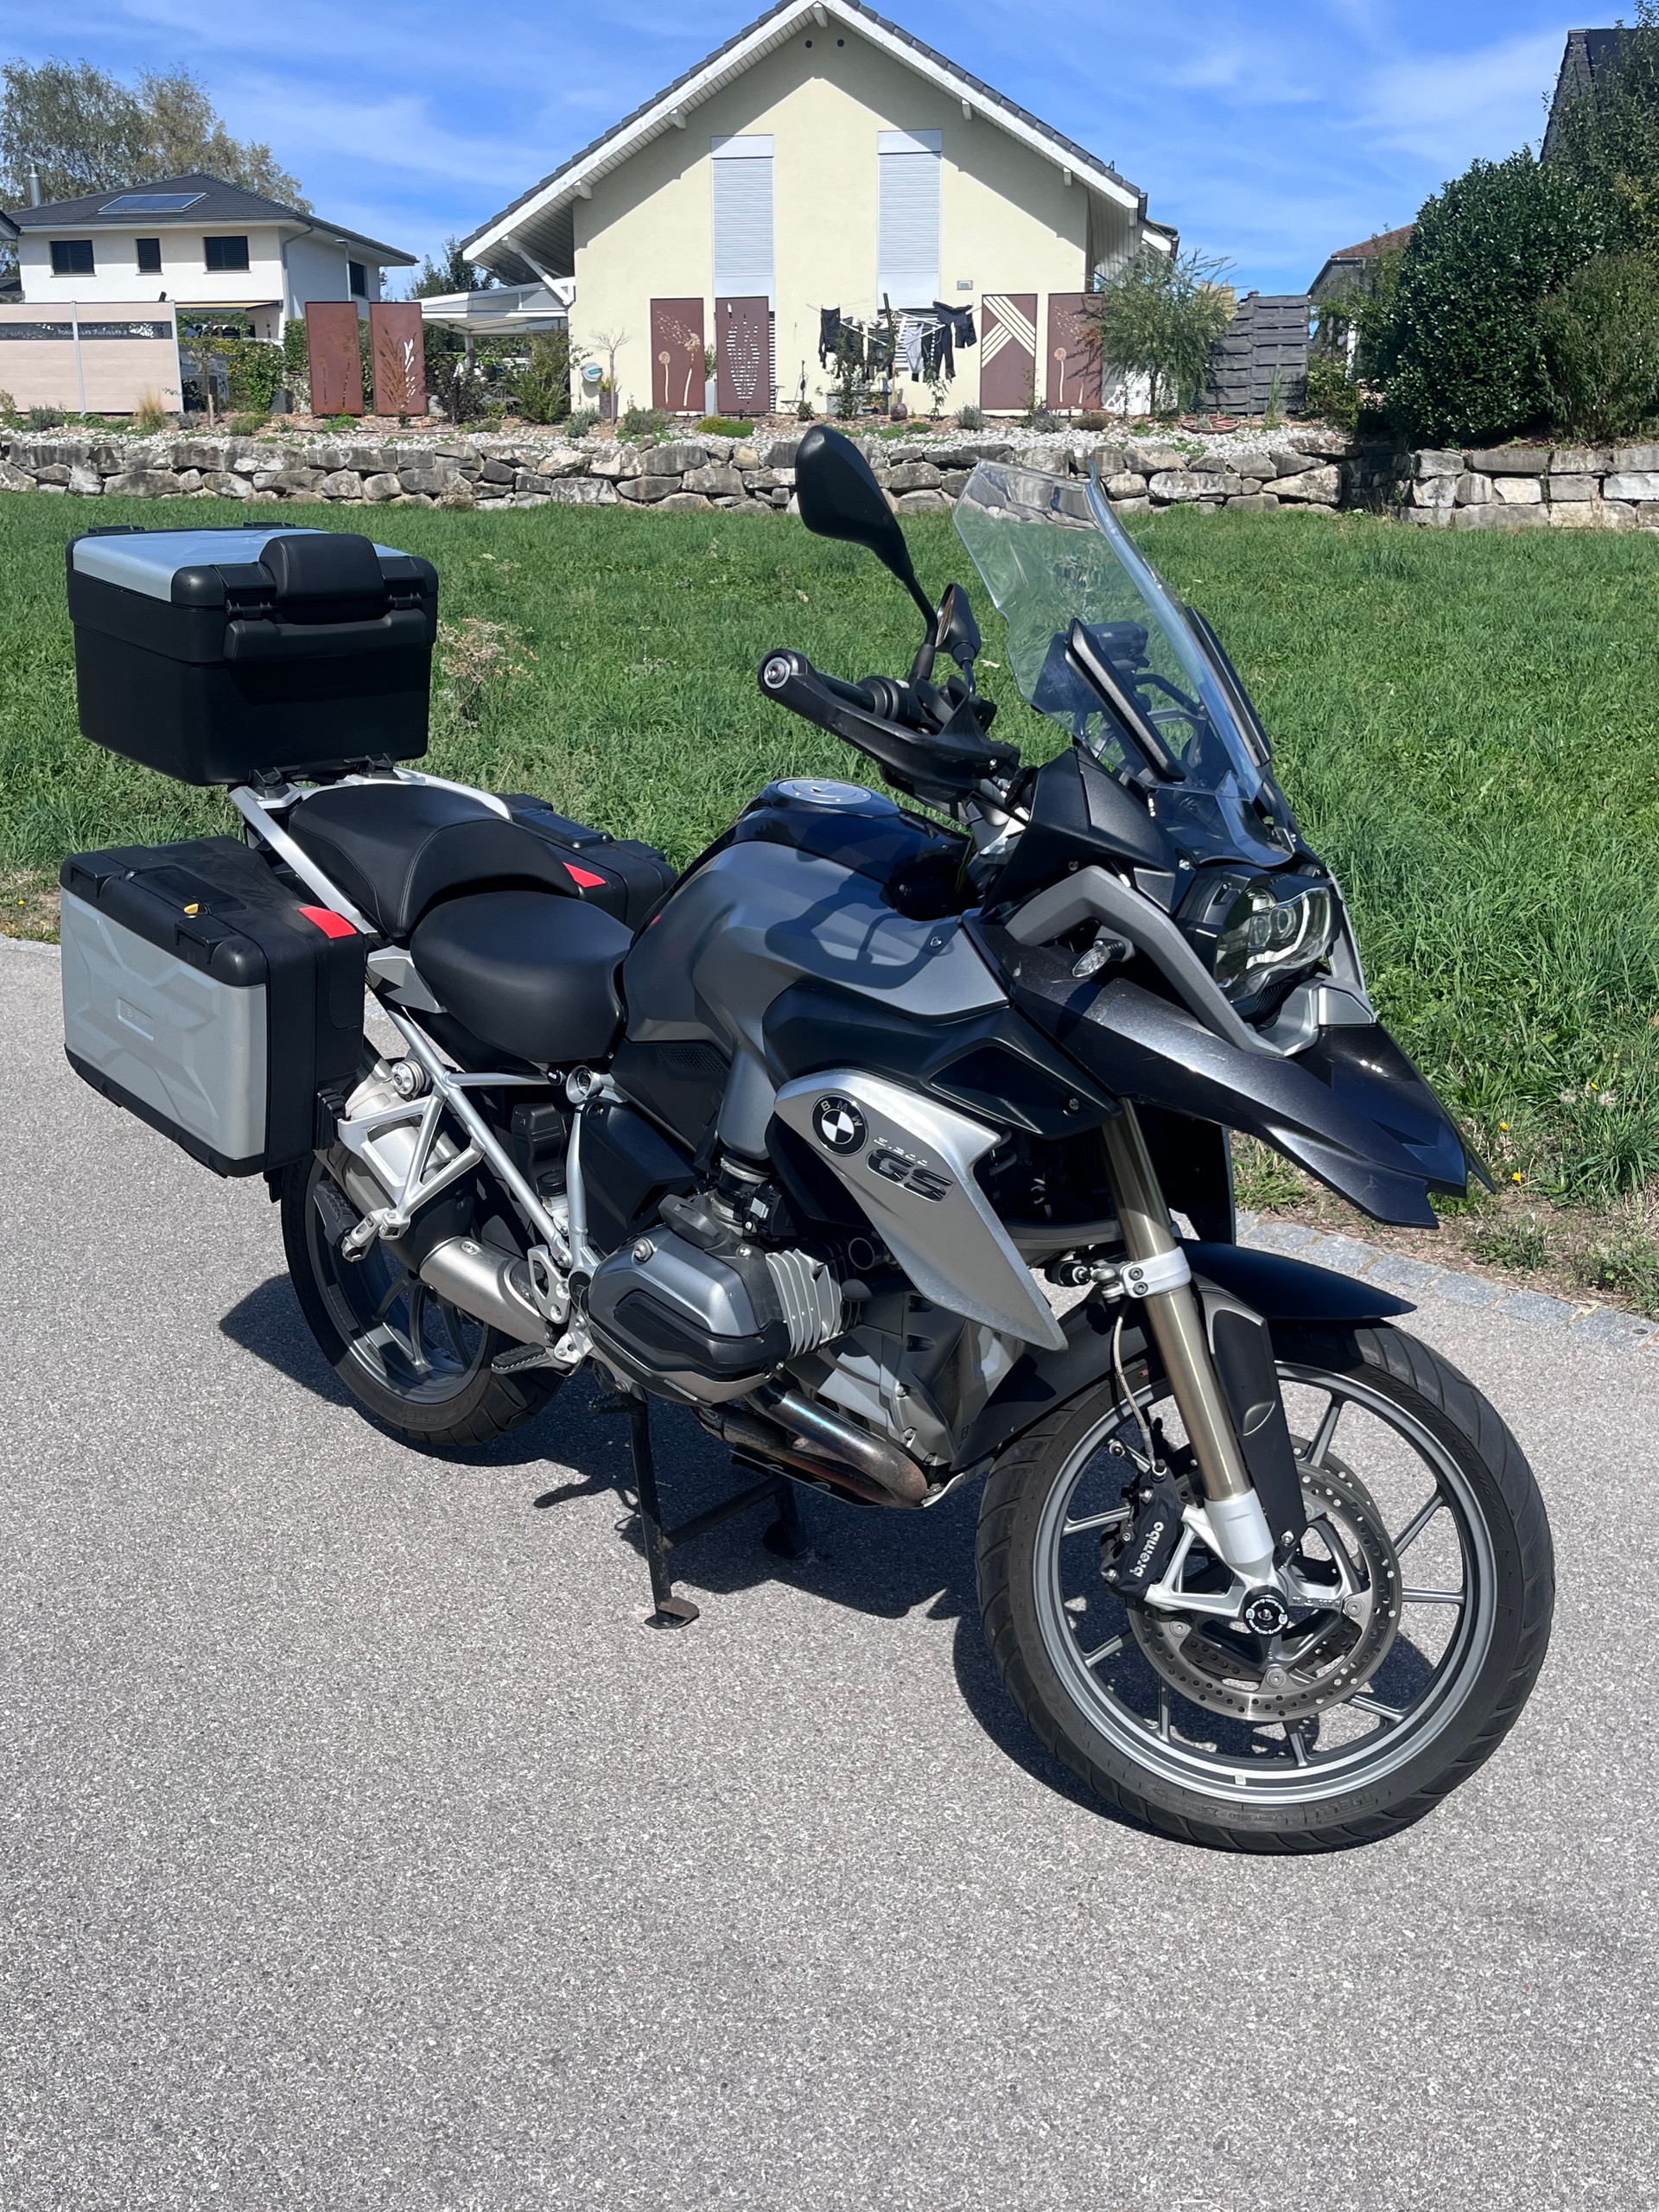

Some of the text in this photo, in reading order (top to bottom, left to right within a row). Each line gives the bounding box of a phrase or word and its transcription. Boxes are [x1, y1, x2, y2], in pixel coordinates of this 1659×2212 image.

[821, 1099, 863, 1128] BMW
[867, 1149, 954, 1203] GS
[1129, 1522, 1164, 1577] brembo
